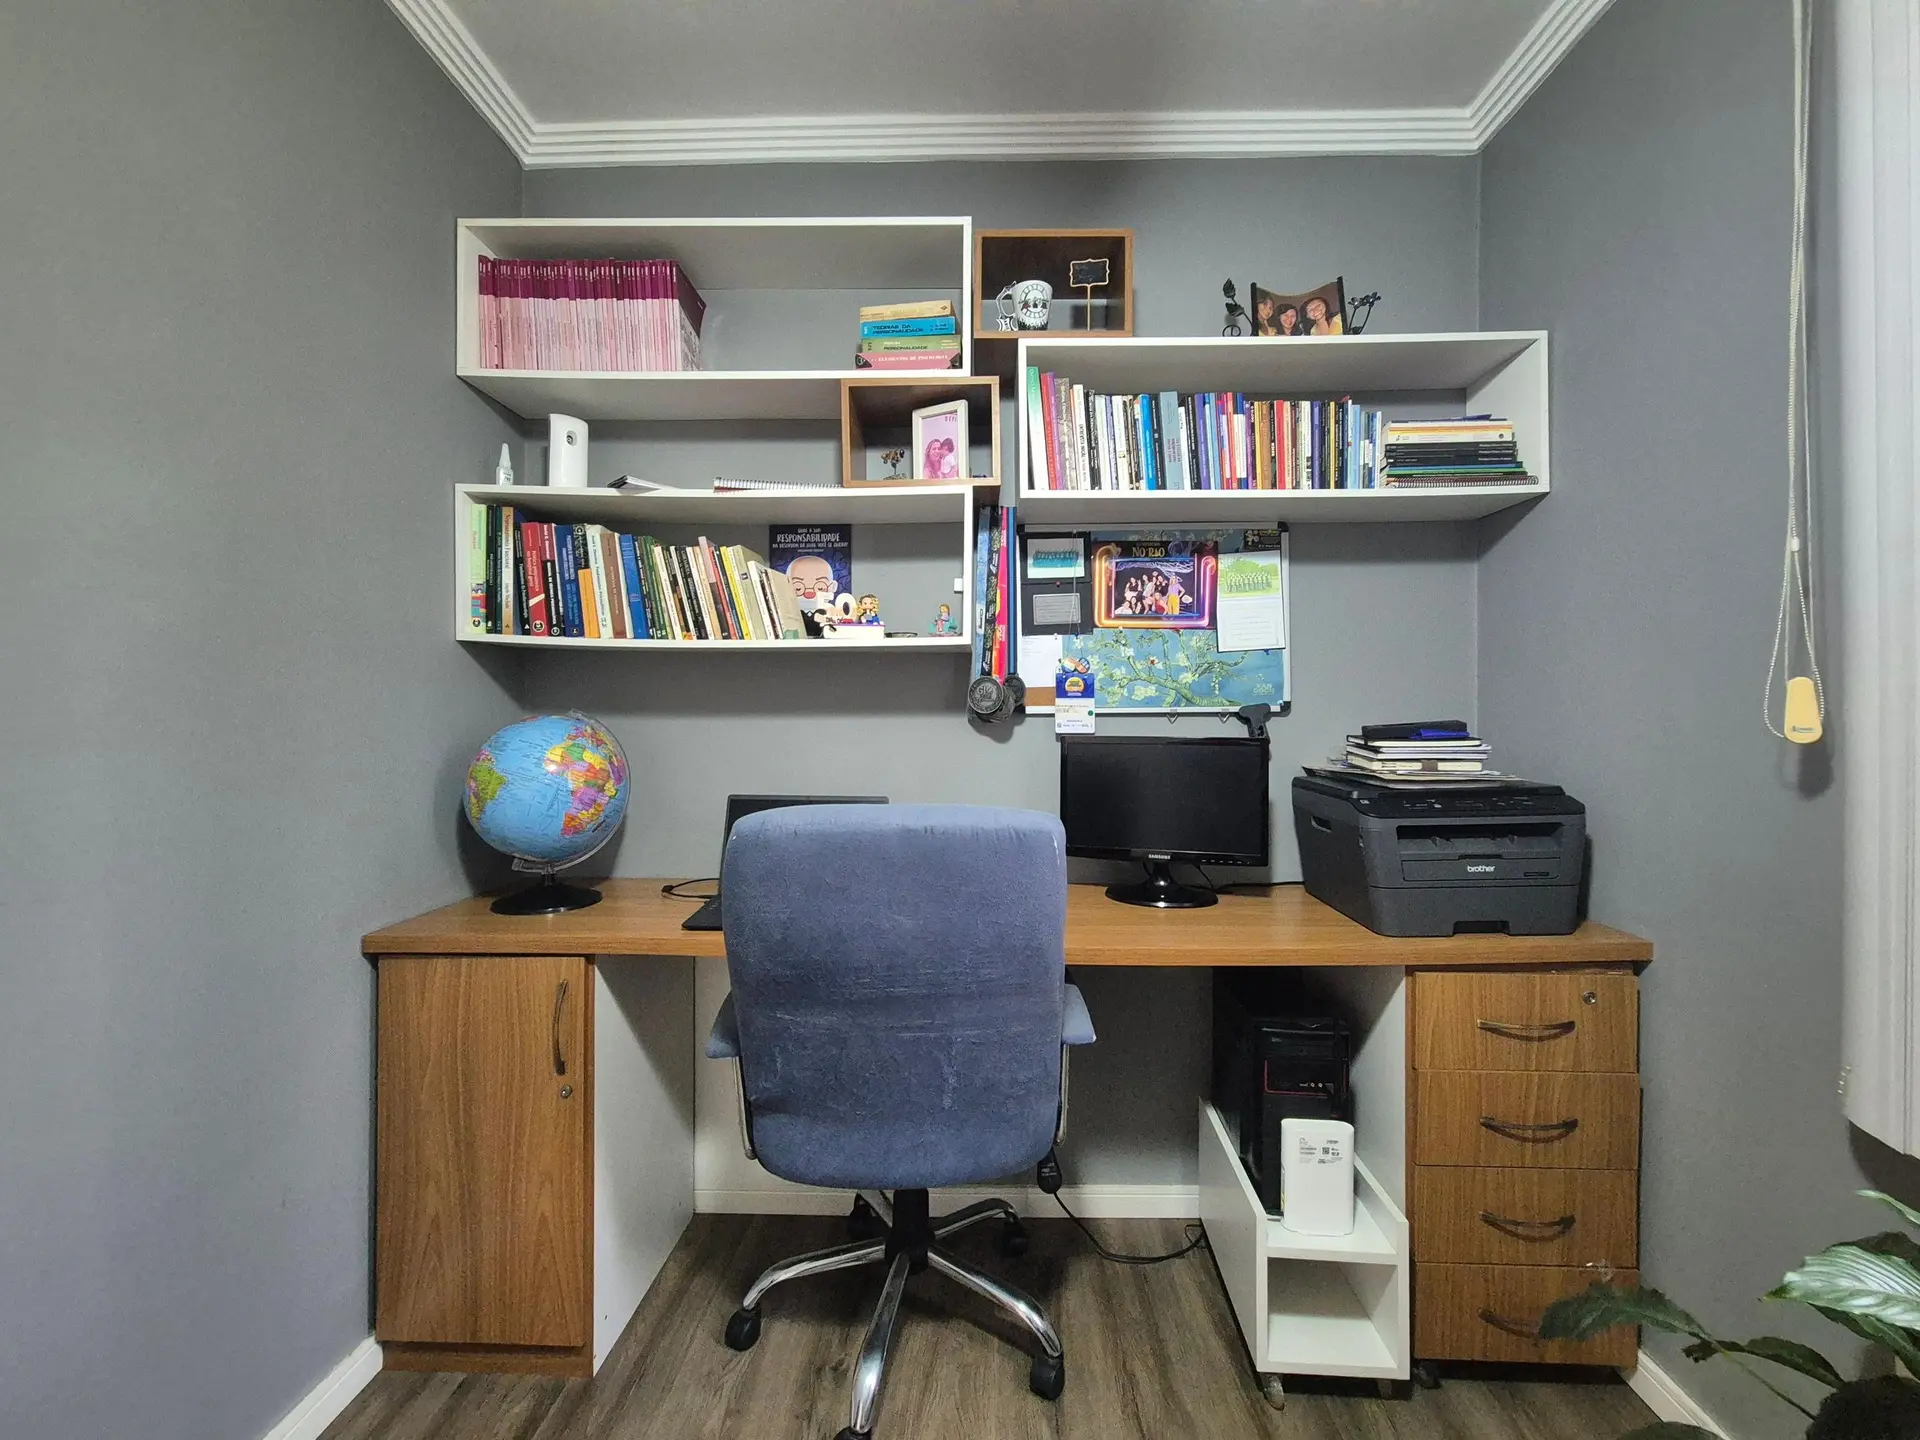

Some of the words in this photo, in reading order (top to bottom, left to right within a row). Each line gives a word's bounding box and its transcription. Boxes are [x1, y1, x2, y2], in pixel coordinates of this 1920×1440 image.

[777, 533, 840, 543] RESPONSABILIDADE
[1132, 547, 1146, 557] NO
[1467, 865, 1495, 873] brother
